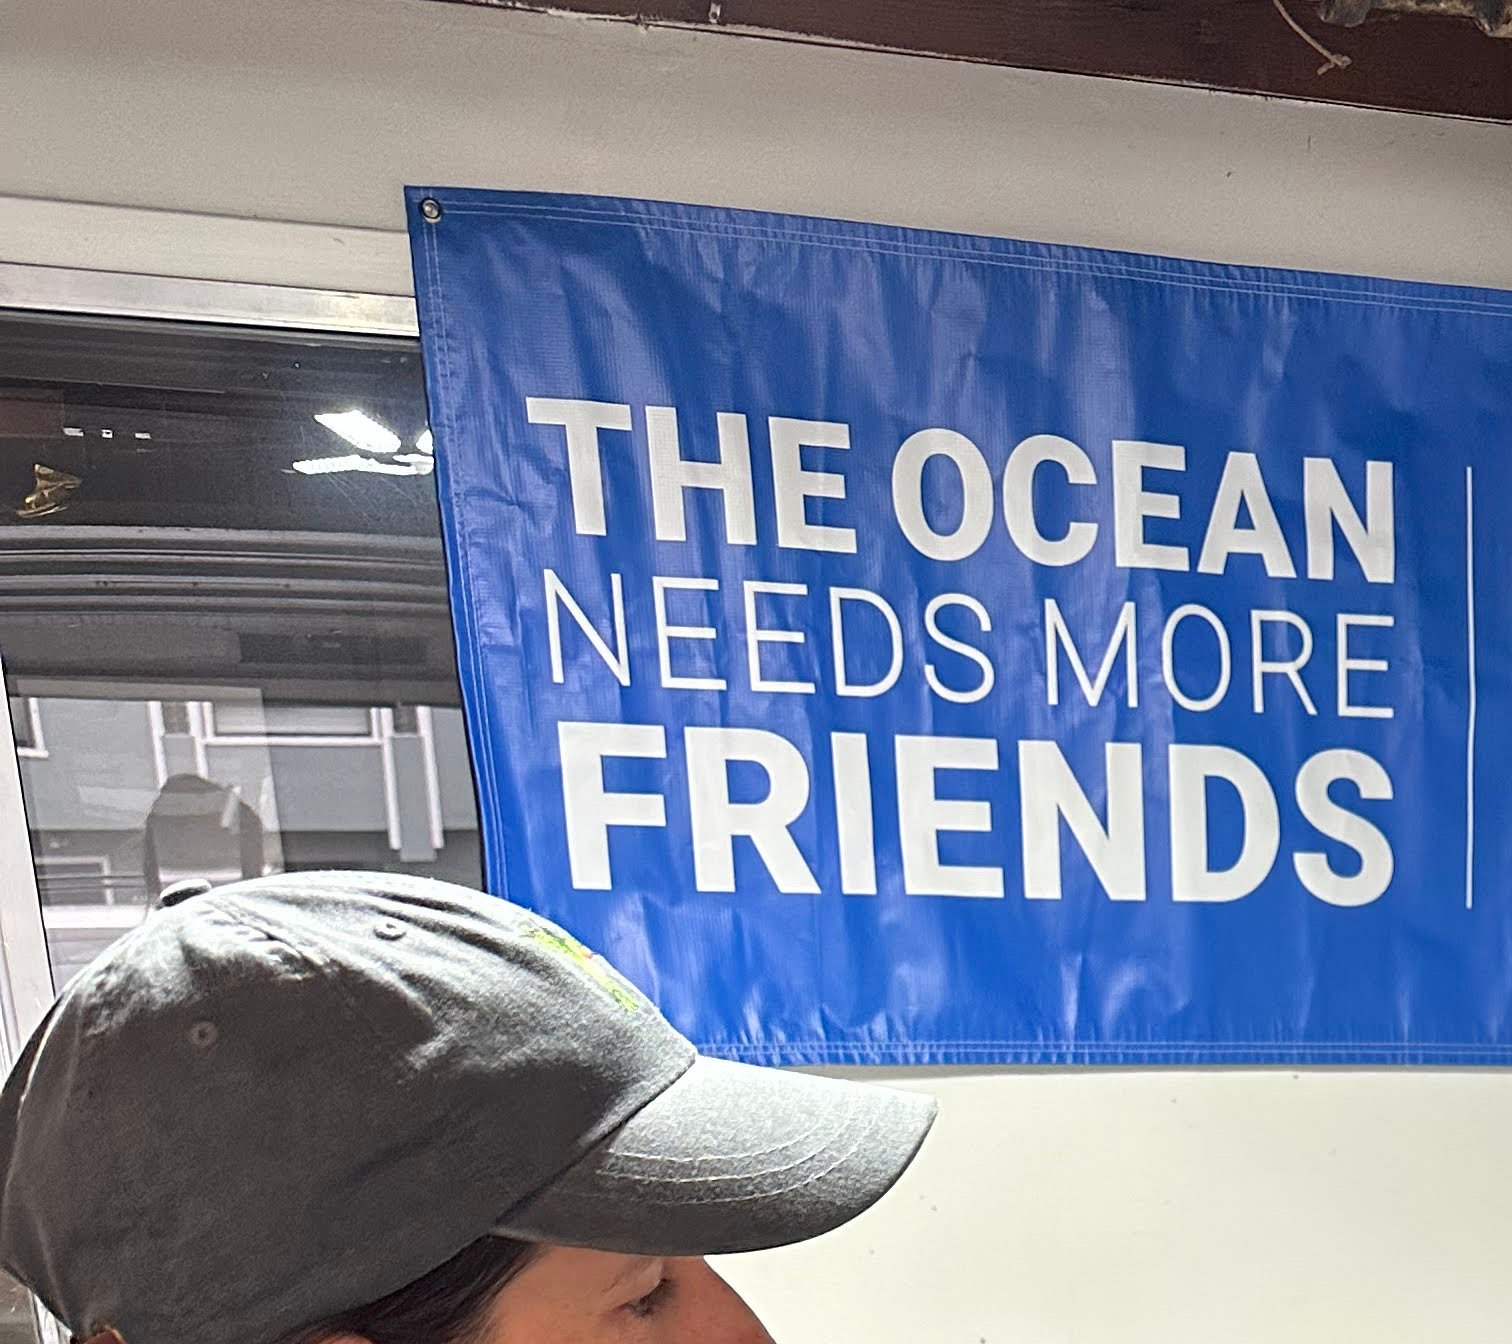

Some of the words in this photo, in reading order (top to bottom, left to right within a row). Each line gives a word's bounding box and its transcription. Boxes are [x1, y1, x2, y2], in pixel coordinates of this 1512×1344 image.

[525, 396, 857, 553] THE
[892, 428, 1394, 583] OCEAN
[544, 569, 994, 703] NEEDS
[1045, 599, 1394, 718] MORE
[557, 720, 1393, 906] FRIENDS
